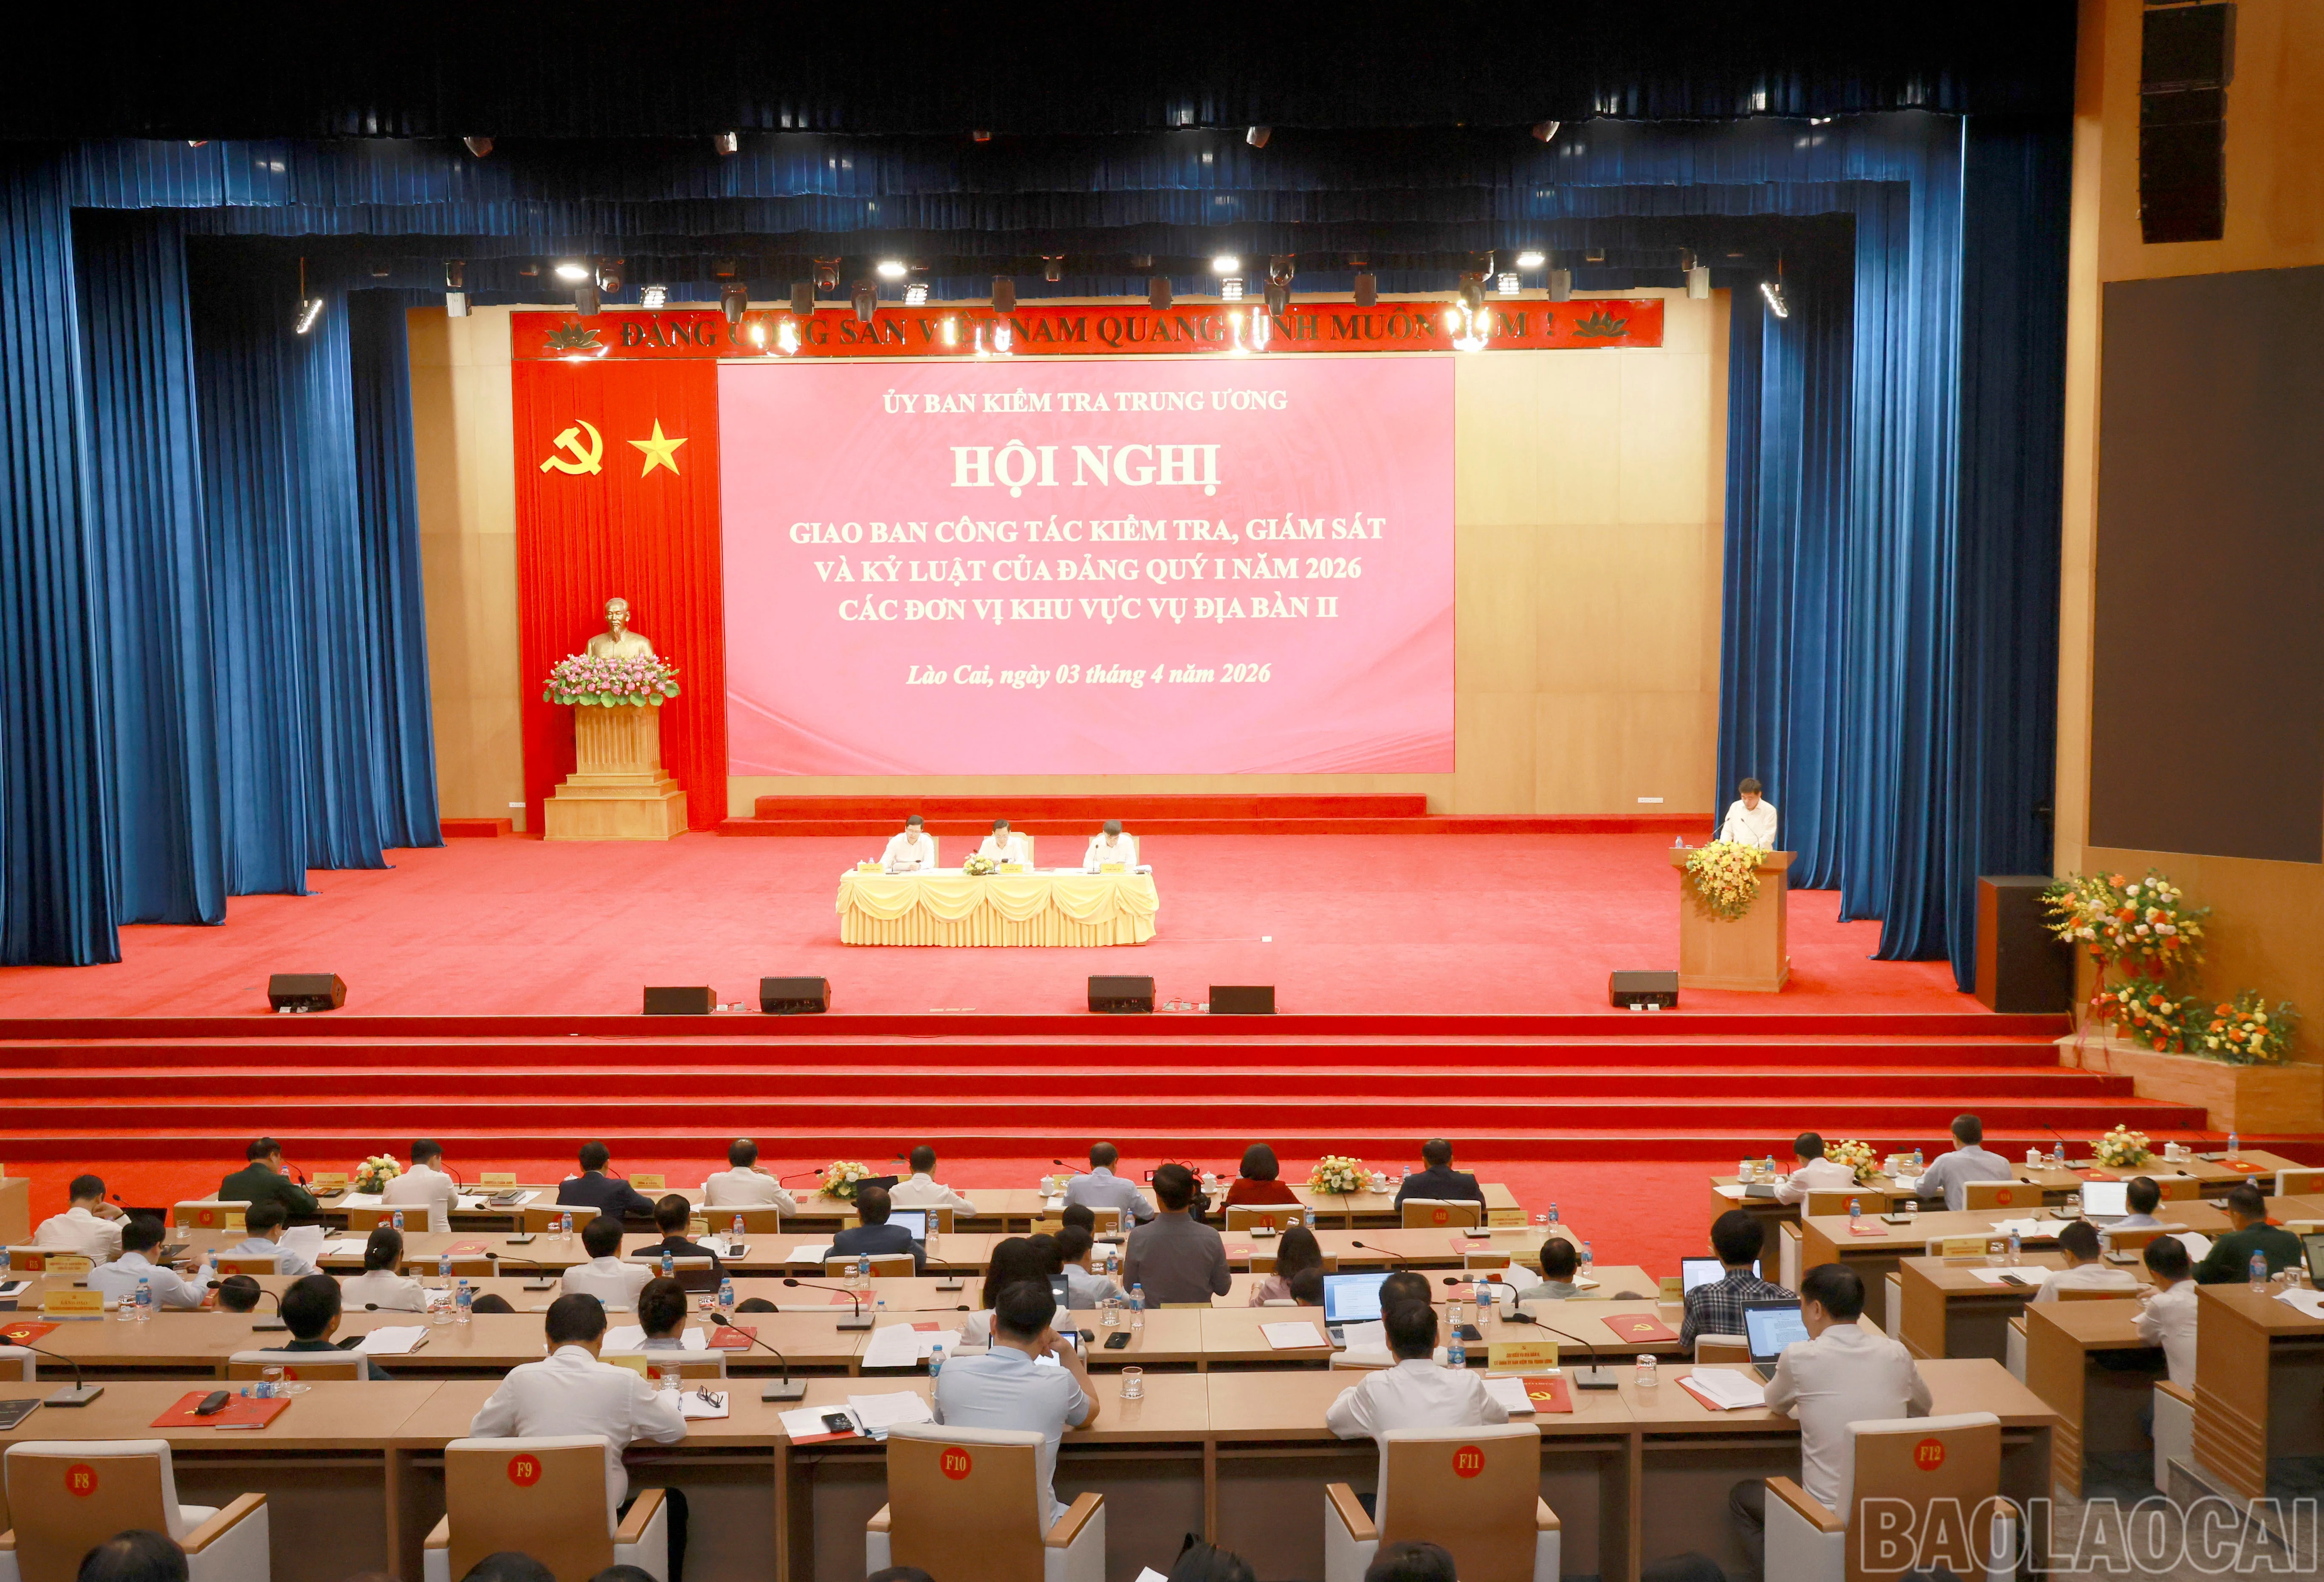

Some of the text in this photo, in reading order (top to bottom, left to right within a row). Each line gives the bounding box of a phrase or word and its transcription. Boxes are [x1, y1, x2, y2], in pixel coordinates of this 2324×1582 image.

[620, 314, 717, 347] ĐẢNG
[917, 311, 1000, 347] VỆT
[1007, 317, 1088, 343] NAM
[1097, 315, 1225, 348] QUANG
[1329, 306, 1438, 340] MUÔN
[883, 387, 1288, 413] ỦY BAN KIỂM TRA TRUNG ƯƠNG
[950, 439, 1221, 498] HỘI NGHỊ
[790, 512, 1385, 545] GIAO BAN CÔNG TÁC KIỂM TRA, GIÁM SÁT
[814, 552, 1361, 587] VÀ KỶ LUẬT CỦA ĐẢNG QUÝ I NĂM 2026
[839, 591, 1338, 625] CÁC ĐƠN VỊ KHU VỰC VỤ ĐỊA BÀN II
[906, 663, 1271, 689] Lào Cai, ngày 03 tháng 4 năm 2026
[1436, 1212, 1446, 1220] A12
[945, 1455, 966, 1471] F10
[1458, 1453, 1478, 1469] F11
[1920, 1446, 1941, 1461] F12
[74, 1473, 89, 1489] F8
[516, 1462, 532, 1477] F9
